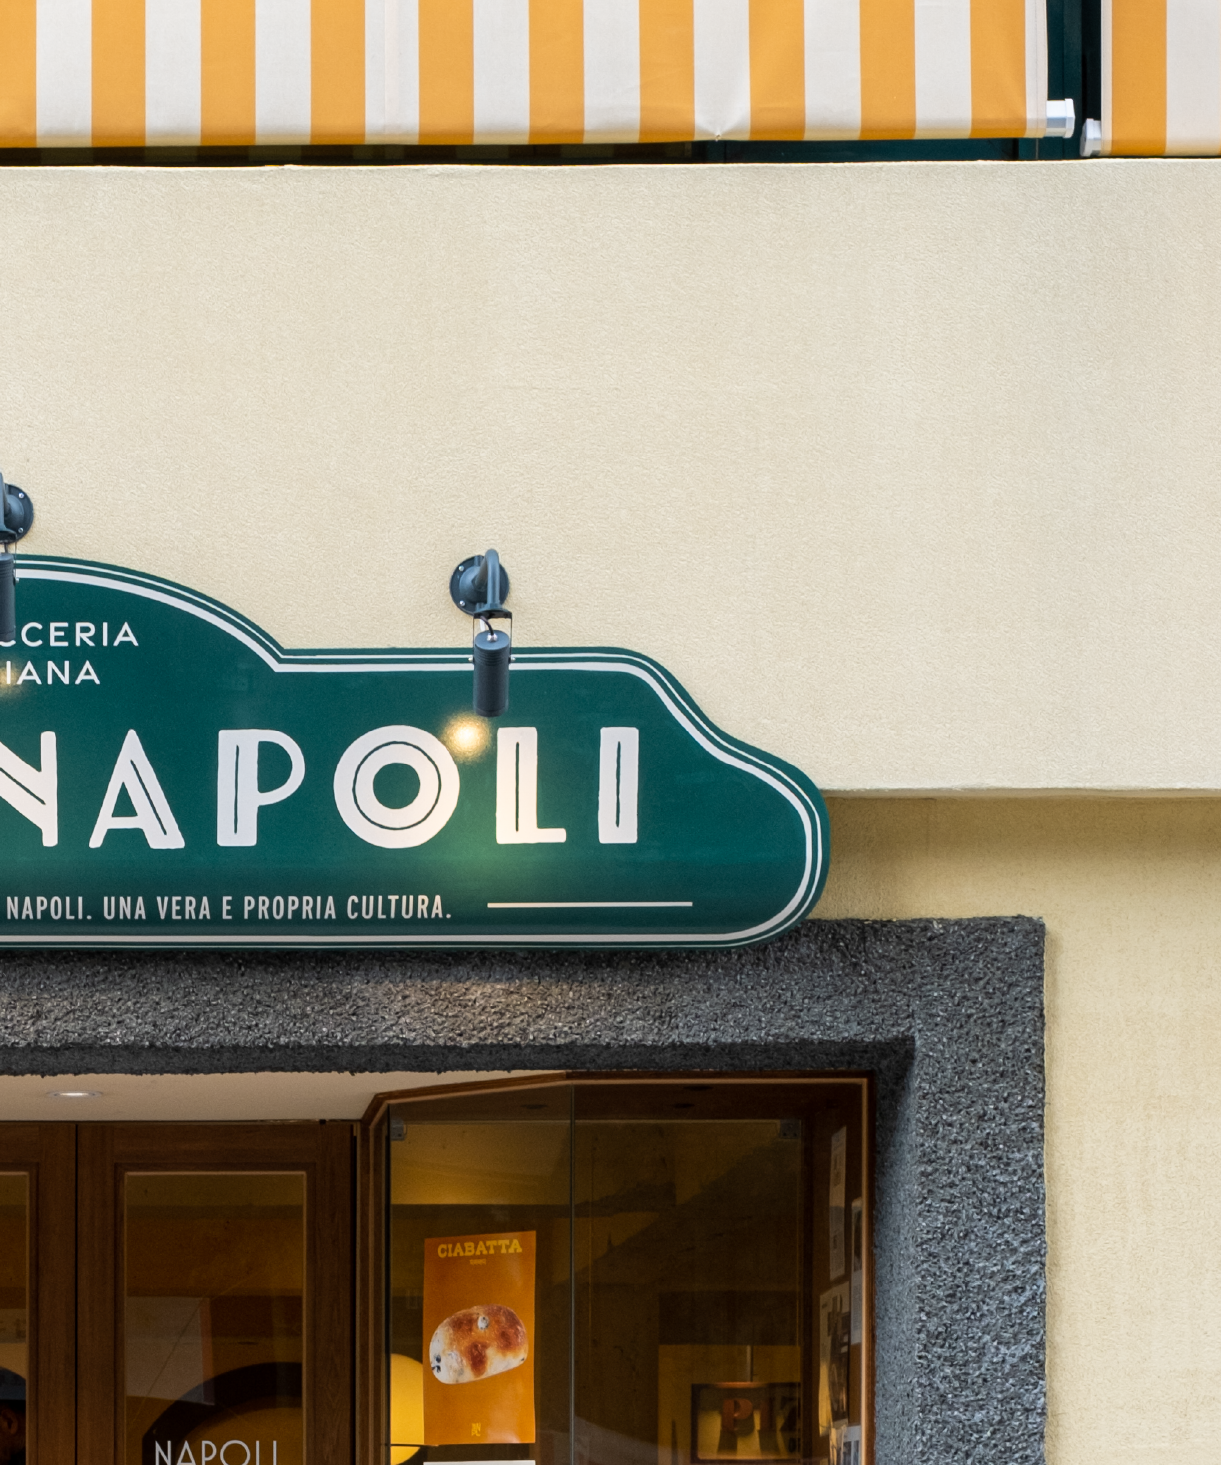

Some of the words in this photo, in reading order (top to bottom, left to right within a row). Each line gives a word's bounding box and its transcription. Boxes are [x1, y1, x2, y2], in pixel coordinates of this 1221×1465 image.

[6, 895, 93, 921] NAPOLI.
[103, 895, 147, 921] UNA
[156, 895, 211, 921] VERA
[221, 895, 233, 921] E
[243, 895, 337, 921] PROPRIA
[346, 895, 453, 921] CULTURA.
[437, 1238, 523, 1258] CIABATTA
